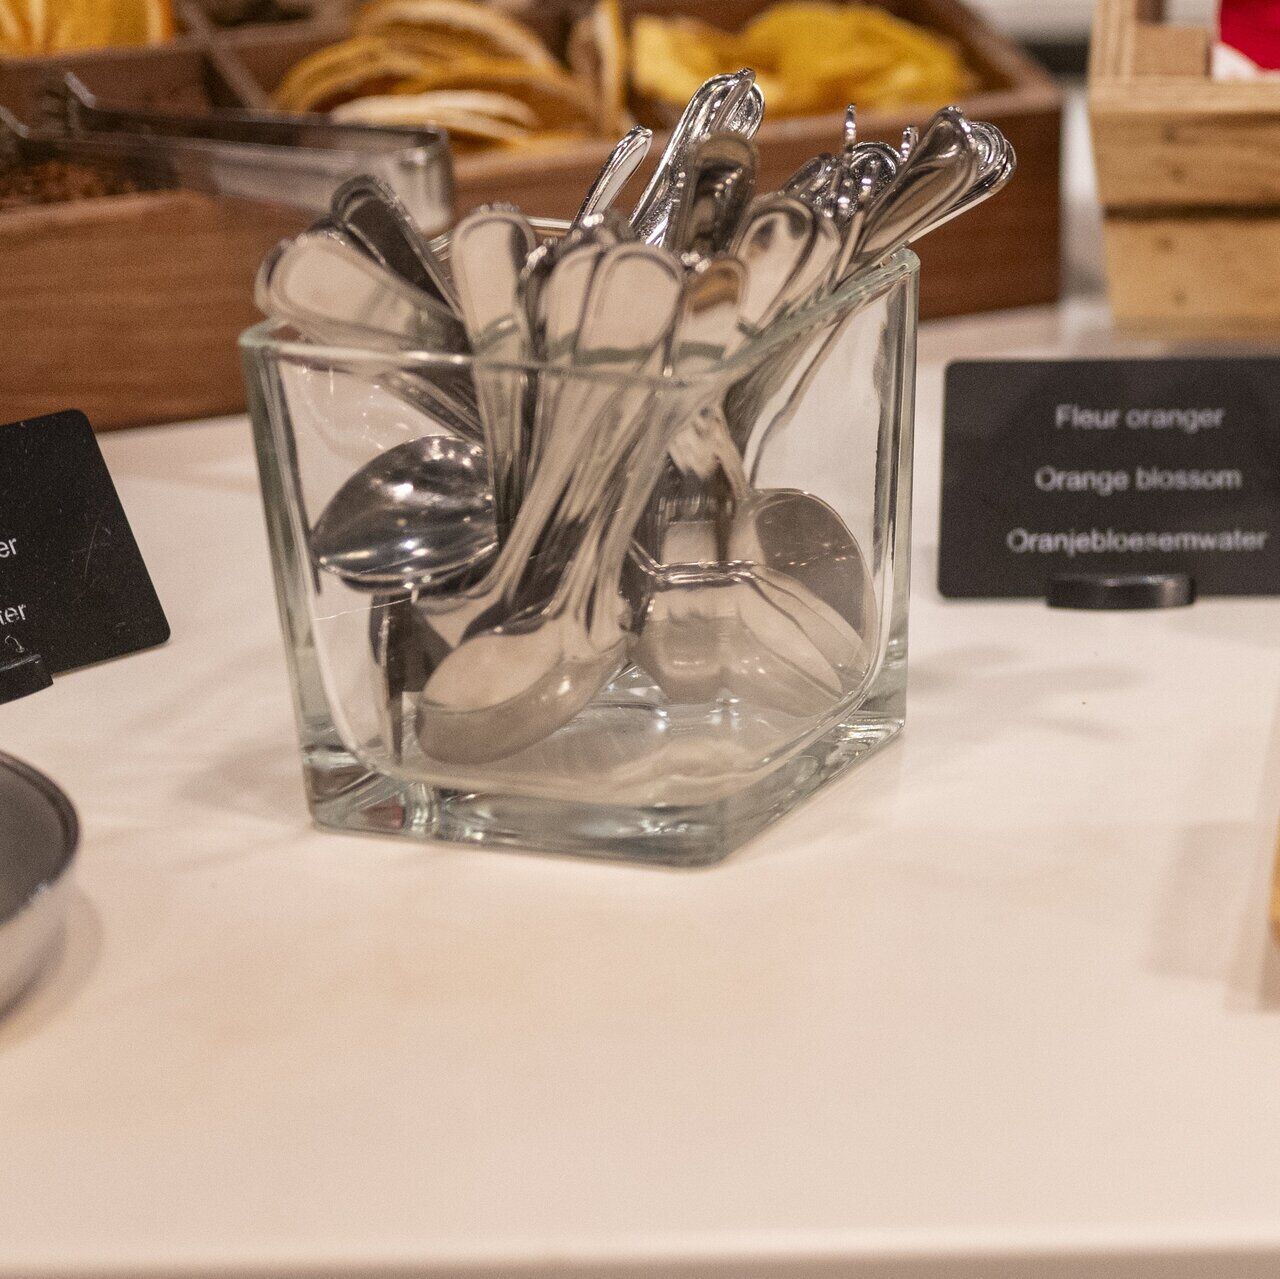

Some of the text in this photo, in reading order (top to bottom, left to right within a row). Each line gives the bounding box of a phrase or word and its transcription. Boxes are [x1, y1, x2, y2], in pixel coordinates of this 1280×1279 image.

[1054, 403, 1225, 434] Fleur oranger
[1034, 464, 1243, 496] Orange blossom
